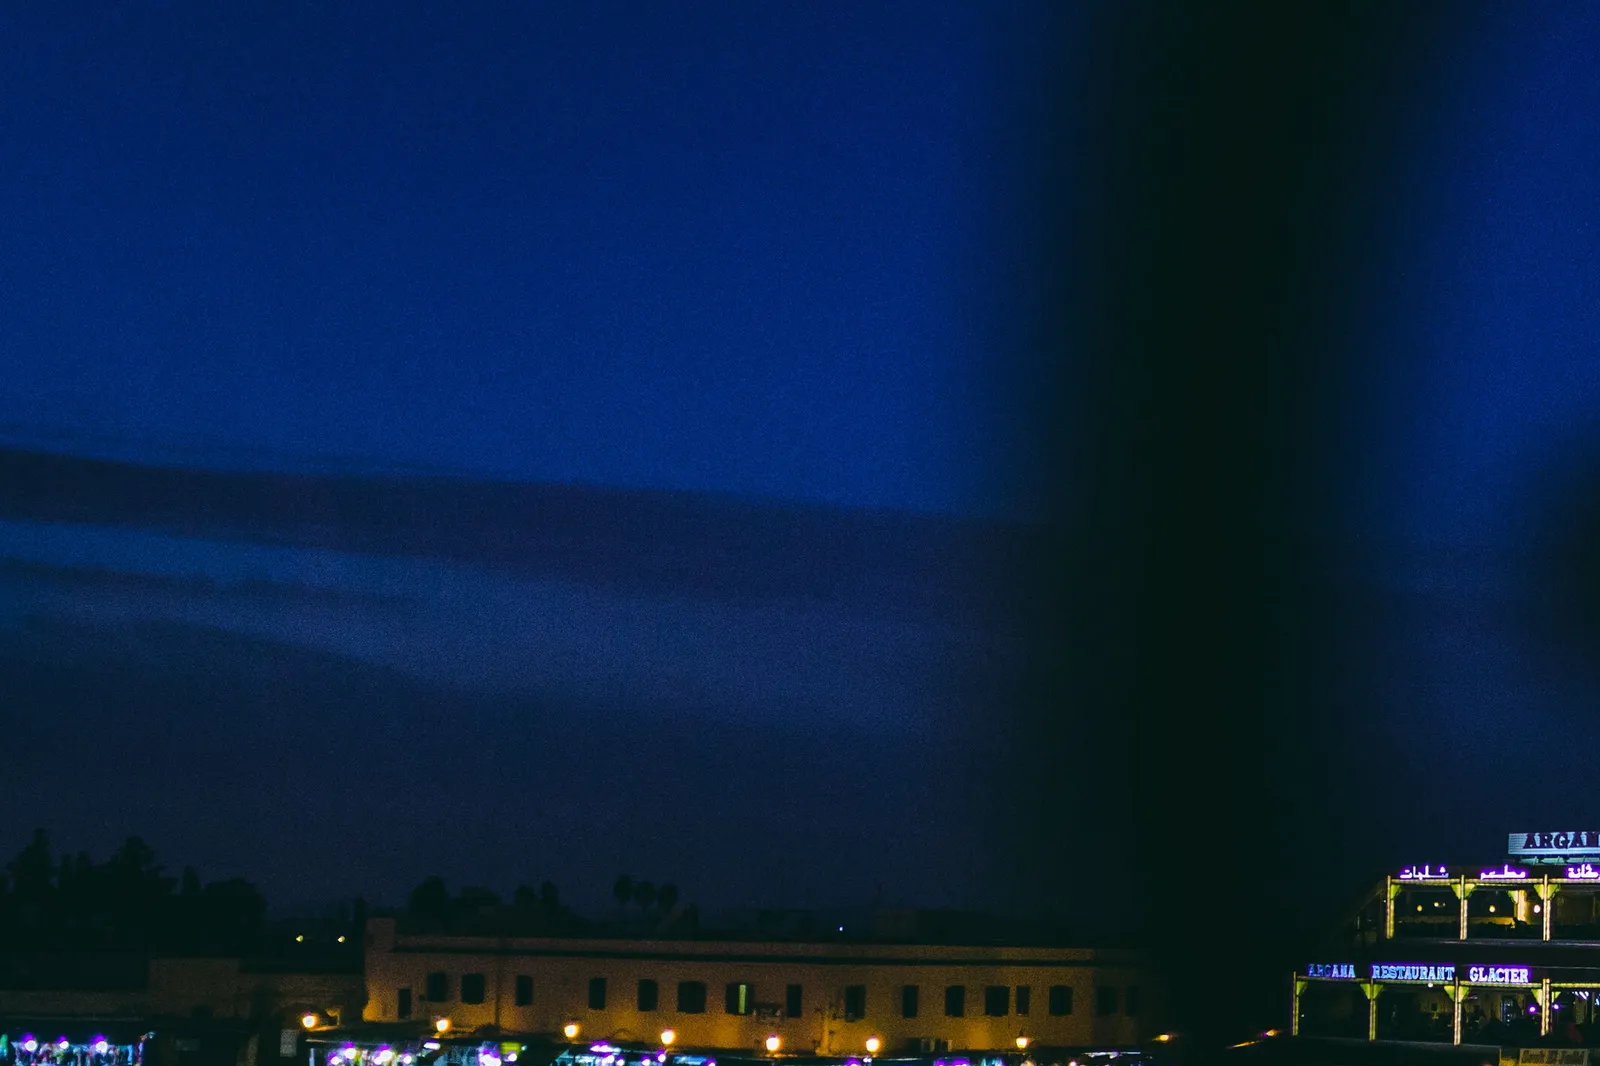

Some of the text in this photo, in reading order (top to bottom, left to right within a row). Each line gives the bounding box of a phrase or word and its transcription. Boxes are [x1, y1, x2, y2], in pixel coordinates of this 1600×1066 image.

[1480, 863, 1526, 881] مطعم
[1307, 963, 1530, 984] ARGANA RESTAURANT GLACIER
